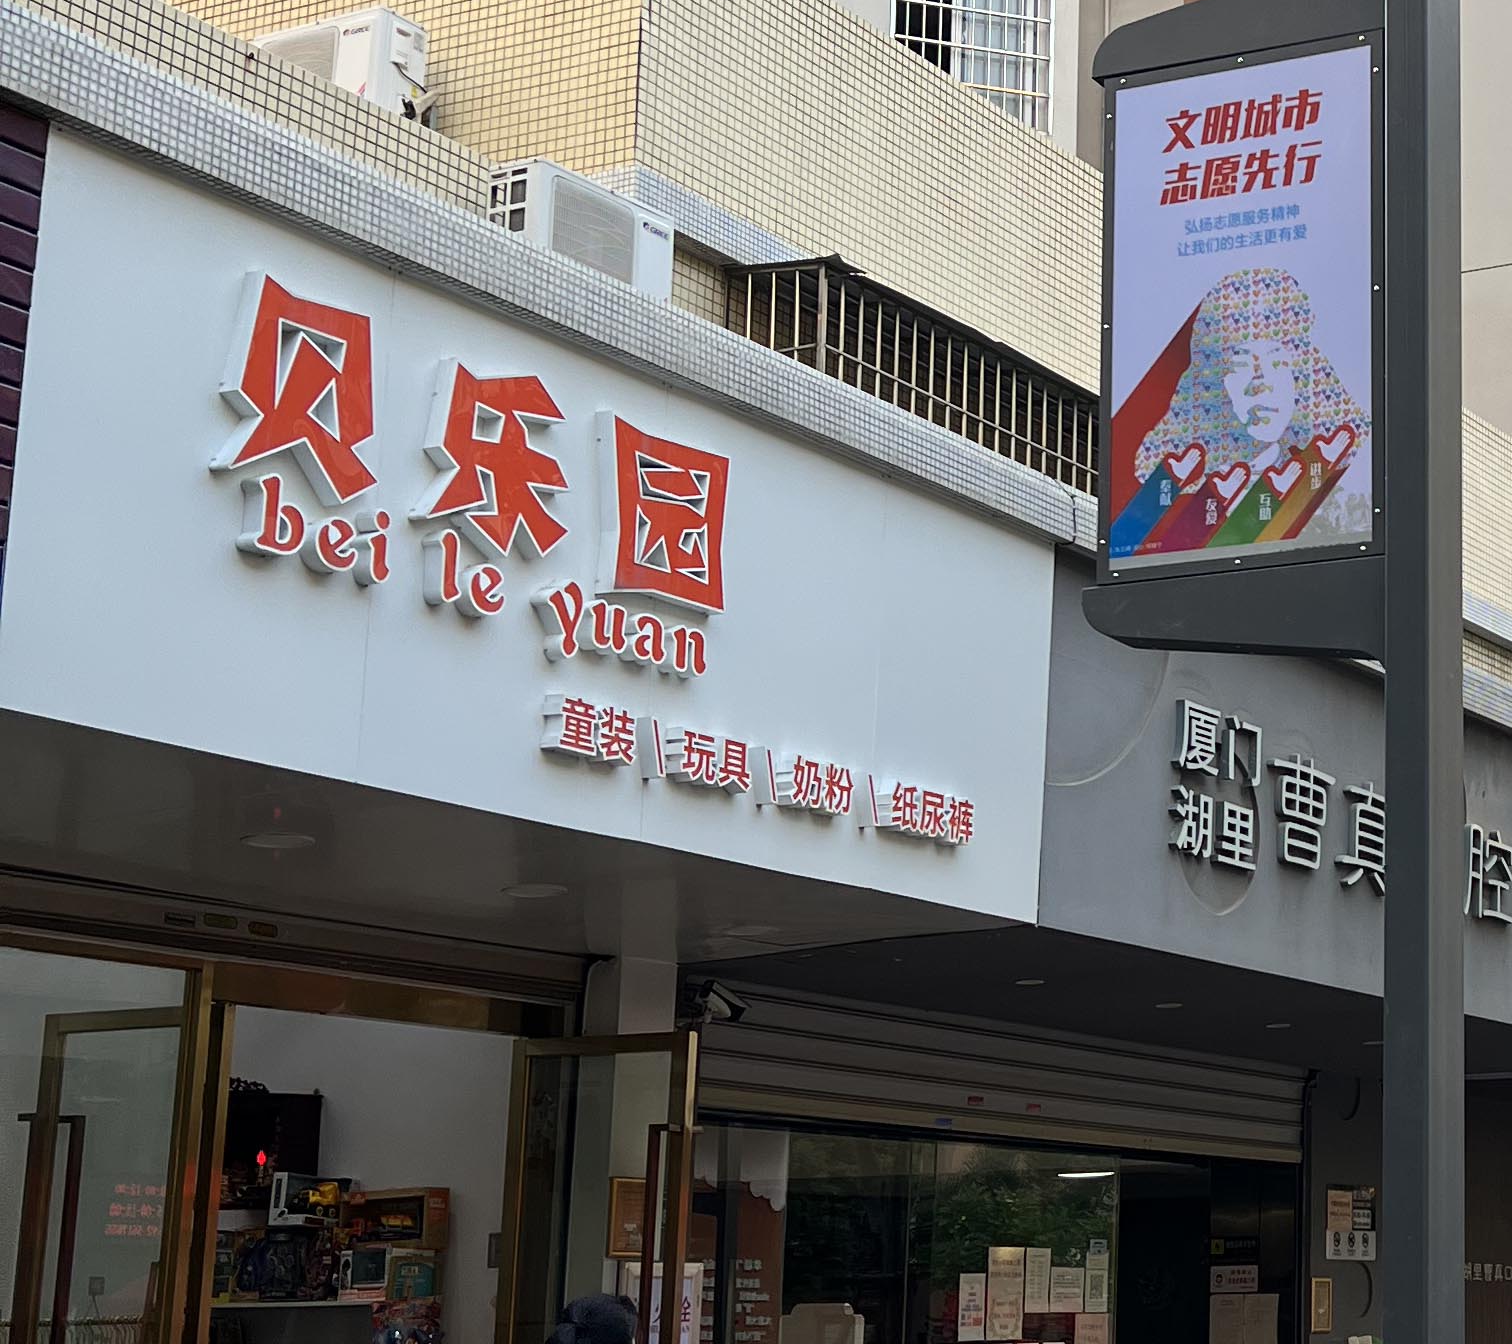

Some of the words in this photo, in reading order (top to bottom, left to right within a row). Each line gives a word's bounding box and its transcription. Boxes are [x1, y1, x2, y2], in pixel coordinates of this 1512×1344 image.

[1162, 88, 1323, 154] 文明城市
[1160, 140, 1323, 206] 志愿先行
[1177, 224, 1308, 257] 让我们的生活更有爱
[1184, 204, 1300, 236] 弘扬志愿服务精神
[212, 272, 732, 614] 贝乐园
[245, 474, 391, 587] bei
[435, 528, 505, 615] le
[556, 696, 636, 766] 童装
[676, 726, 752, 792] 玩具
[790, 755, 854, 816] 奶粉
[887, 779, 975, 846] 纸尿裤
[1171, 698, 1263, 787] 厦门
[1168, 785, 1256, 872] 湖里
